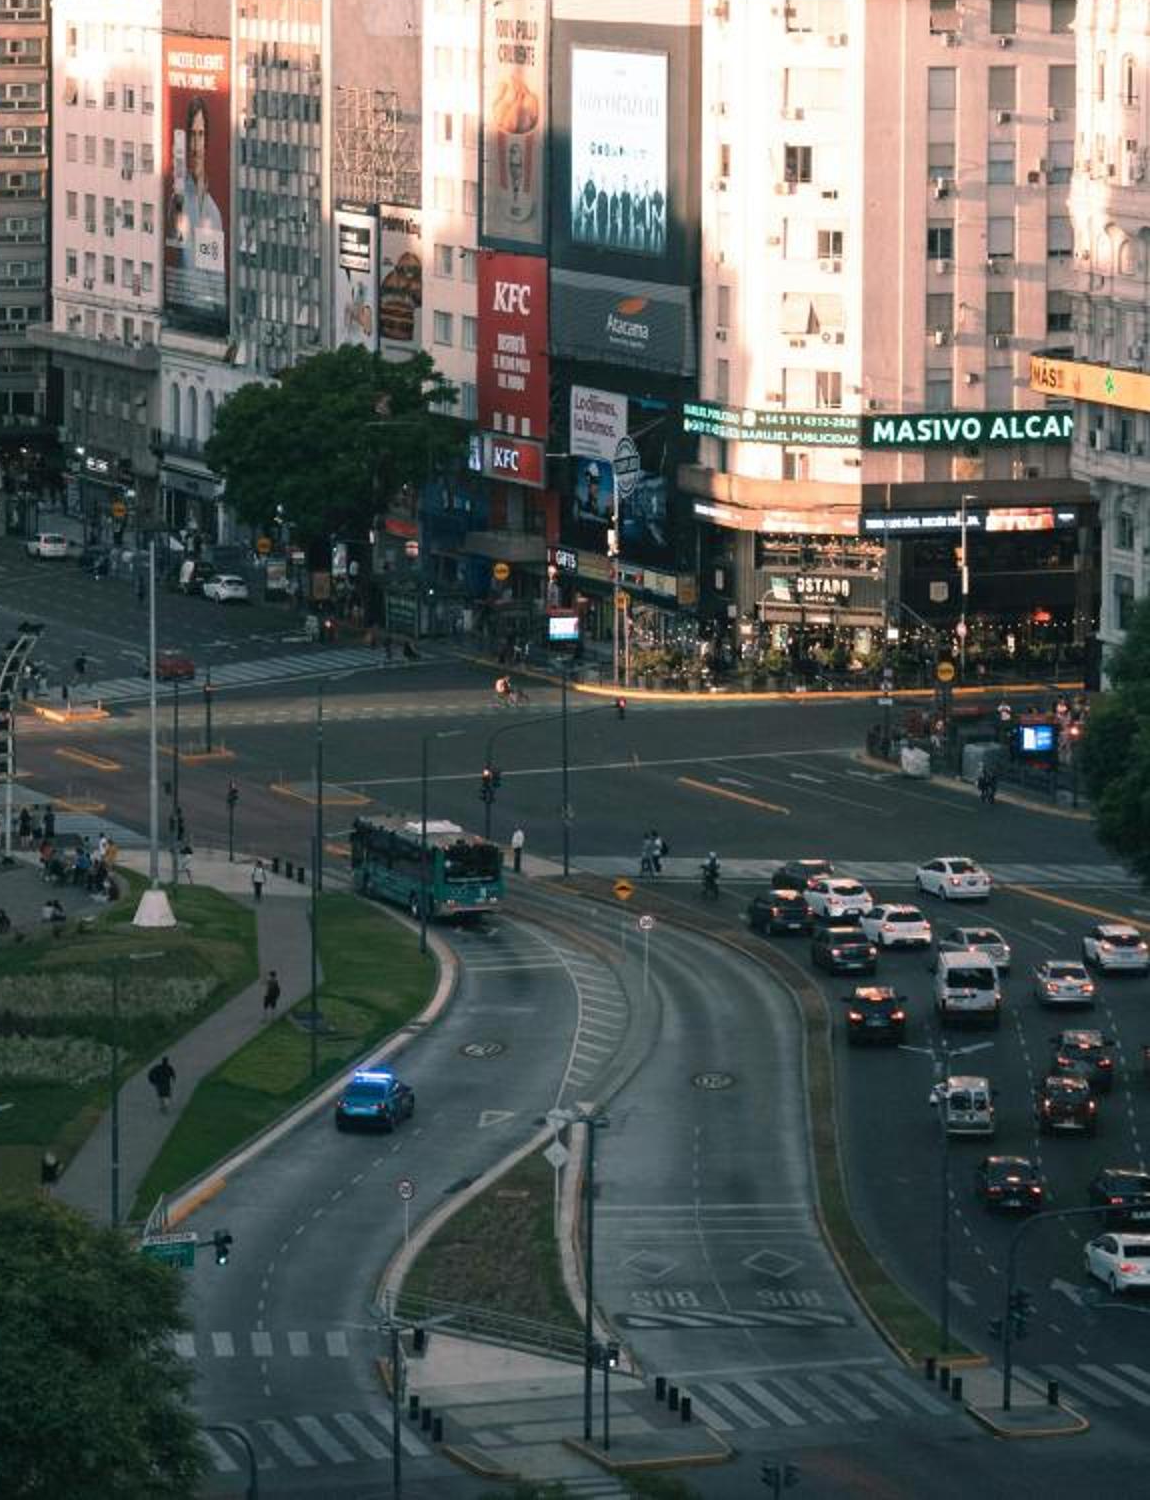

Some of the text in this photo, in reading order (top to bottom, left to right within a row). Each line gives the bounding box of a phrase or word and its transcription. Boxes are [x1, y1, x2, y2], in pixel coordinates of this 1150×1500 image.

[493, 281, 531, 315] KFC
[789, 414, 800, 426] 11
[872, 418, 981, 443] MASIVO
[792, 430, 859, 445] PUBLICIDAD
[493, 446, 519, 471] KFC
